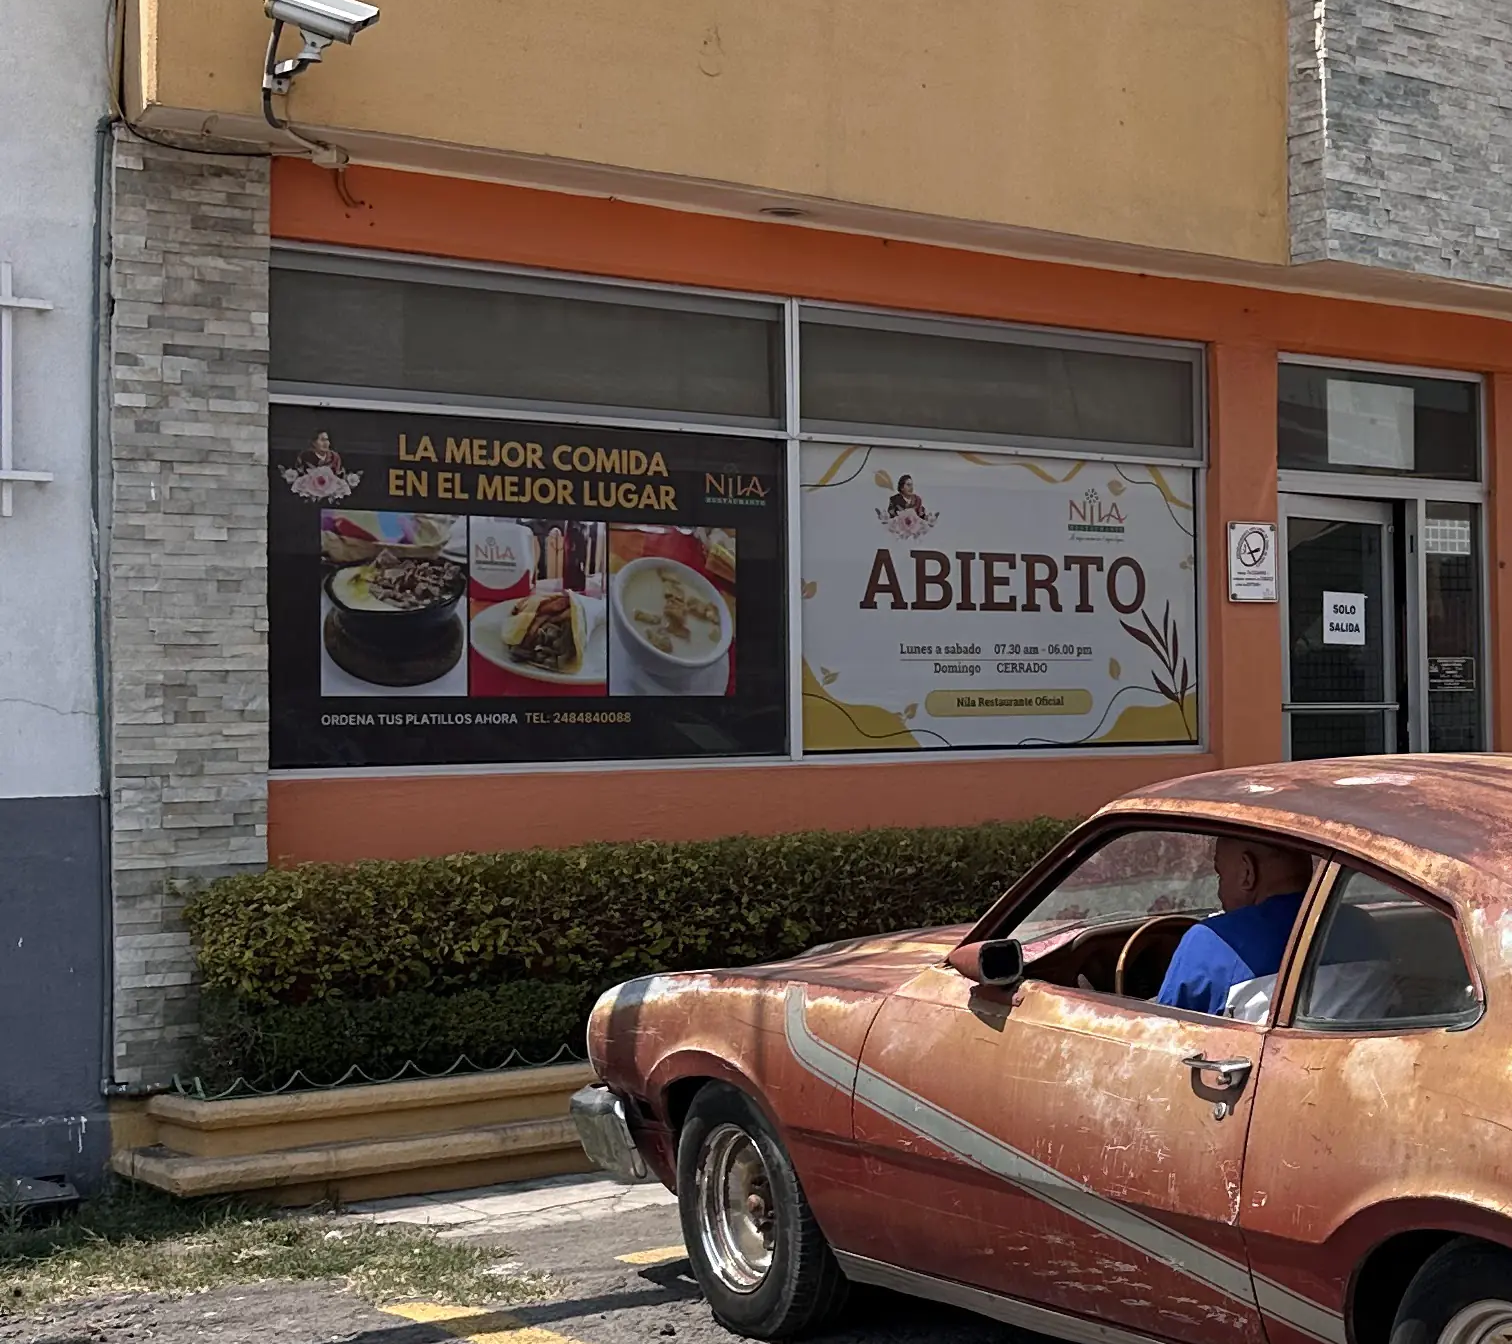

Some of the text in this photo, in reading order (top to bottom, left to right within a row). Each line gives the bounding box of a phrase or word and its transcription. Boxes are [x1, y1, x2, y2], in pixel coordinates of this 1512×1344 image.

[399, 434, 669, 477] LA MEJOR COMIDA
[388, 468, 678, 511] EN EL MEJOR LUGAR
[705, 472, 771, 498] NILA
[1068, 499, 1128, 525] NILA
[858, 548, 1147, 615] ABIERTO
[1332, 604, 1356, 615] SOLO
[1329, 622, 1360, 633] SALIDA
[900, 643, 933, 655] Lunes
[935, 646, 942, 655] a
[944, 643, 981, 655] sabado
[1023, 646, 1039, 655] am
[1076, 646, 1093, 657] pm
[933, 662, 1048, 676] Domingo CERRADO
[956, 697, 976, 708] Nila
[978, 697, 1033, 707] Restaurante
[321, 714, 375, 726] ORDENA
[377, 714, 403, 726] TUS
[405, 713, 472, 725] PLATILLOS
[474, 713, 518, 725] AHORA
[525, 712, 550, 724] TEL:
